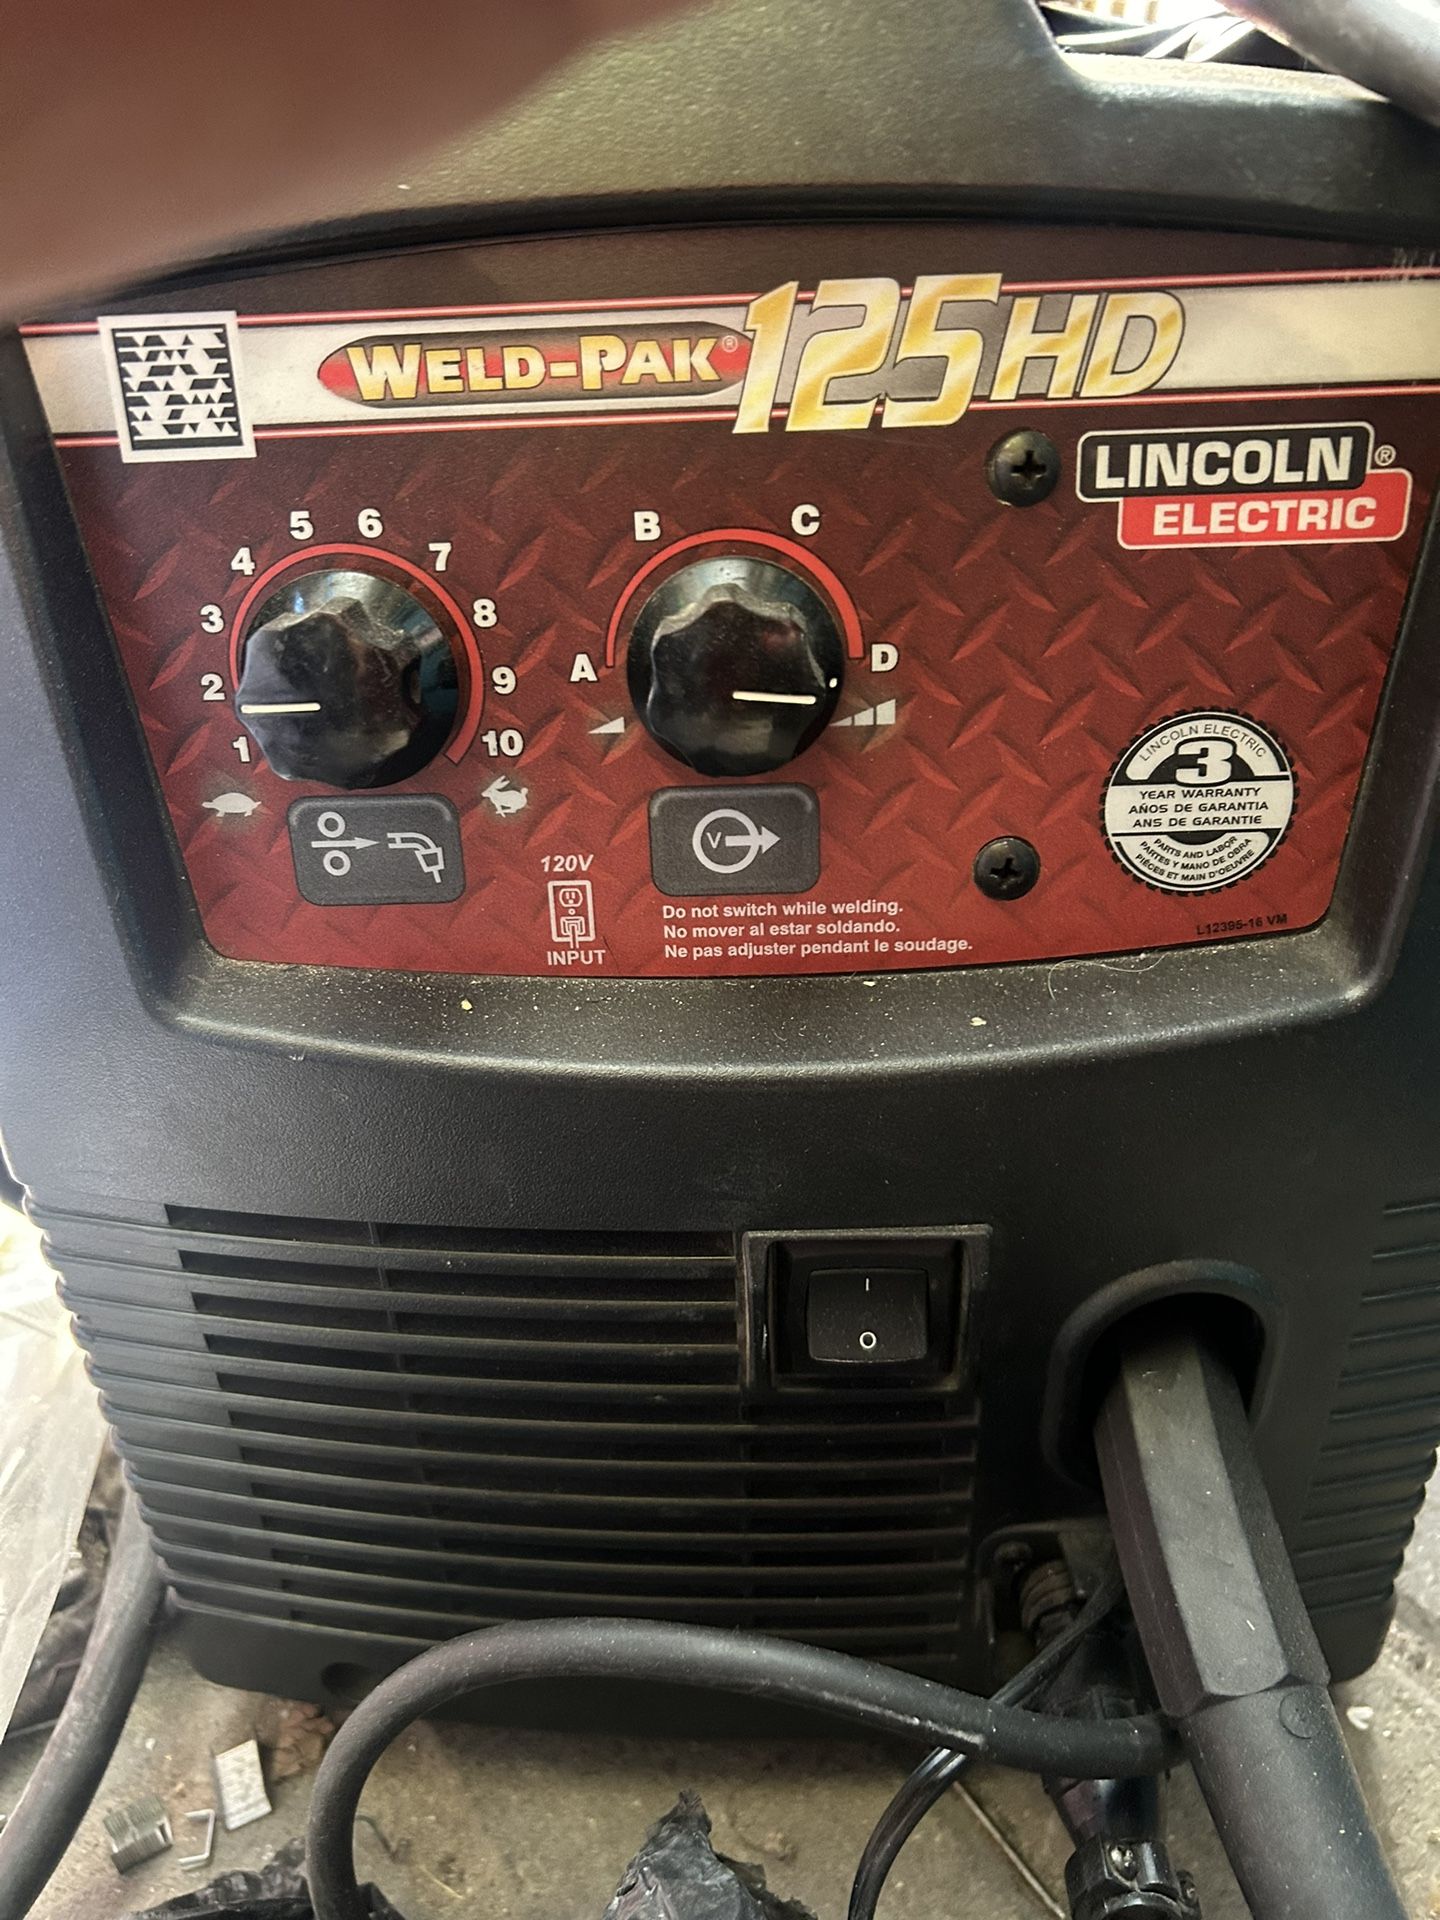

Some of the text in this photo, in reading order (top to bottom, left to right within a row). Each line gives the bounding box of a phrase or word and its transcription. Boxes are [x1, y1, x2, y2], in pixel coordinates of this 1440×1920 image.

[1094, 436, 1354, 490] LINCOLN
[289, 510, 314, 540] 5
[357, 508, 384, 538] 6
[633, 511, 661, 541] B
[791, 504, 820, 536] C
[1152, 497, 1378, 537] ELECTRIC
[230, 547, 256, 576] 4
[428, 542, 452, 571] 7
[199, 604, 225, 634] 3
[472, 599, 498, 628] 8
[569, 653, 598, 683] A
[871, 643, 899, 672] D
[200, 673, 226, 701] 2
[491, 666, 517, 695] 9
[232, 736, 251, 763] 1
[481, 729, 525, 757] 10
[1139, 723, 1267, 762] LINCOLN ELECTRIC
[1175, 740, 1233, 785] 3
[1128, 801, 1269, 815] AÑOS DE GARANTIA
[1139, 787, 1261, 800] YEAR WARRANTY
[1132, 815, 1262, 828] ANS DE GARANTIE
[1139, 841, 1170, 866] PARTES
[1180, 862, 1210, 870] MANO
[1212, 855, 1227, 866] DE
[1227, 838, 1252, 859] OBRA
[1153, 836, 1238, 859] PARTS AND LABOR
[541, 854, 594, 872] 120V
[1166, 871, 1179, 880] ET
[1181, 873, 1206, 881] MAIN
[1208, 849, 1255, 878] D'OEUVRE
[662, 899, 903, 919] Do not switch while welding.
[1266, 914, 1288, 925] VM
[663, 919, 900, 938] No mover al estar soldando.
[547, 949, 606, 965] INPUT
[664, 937, 973, 960] Ne pas adjuster pendant le soudage.
